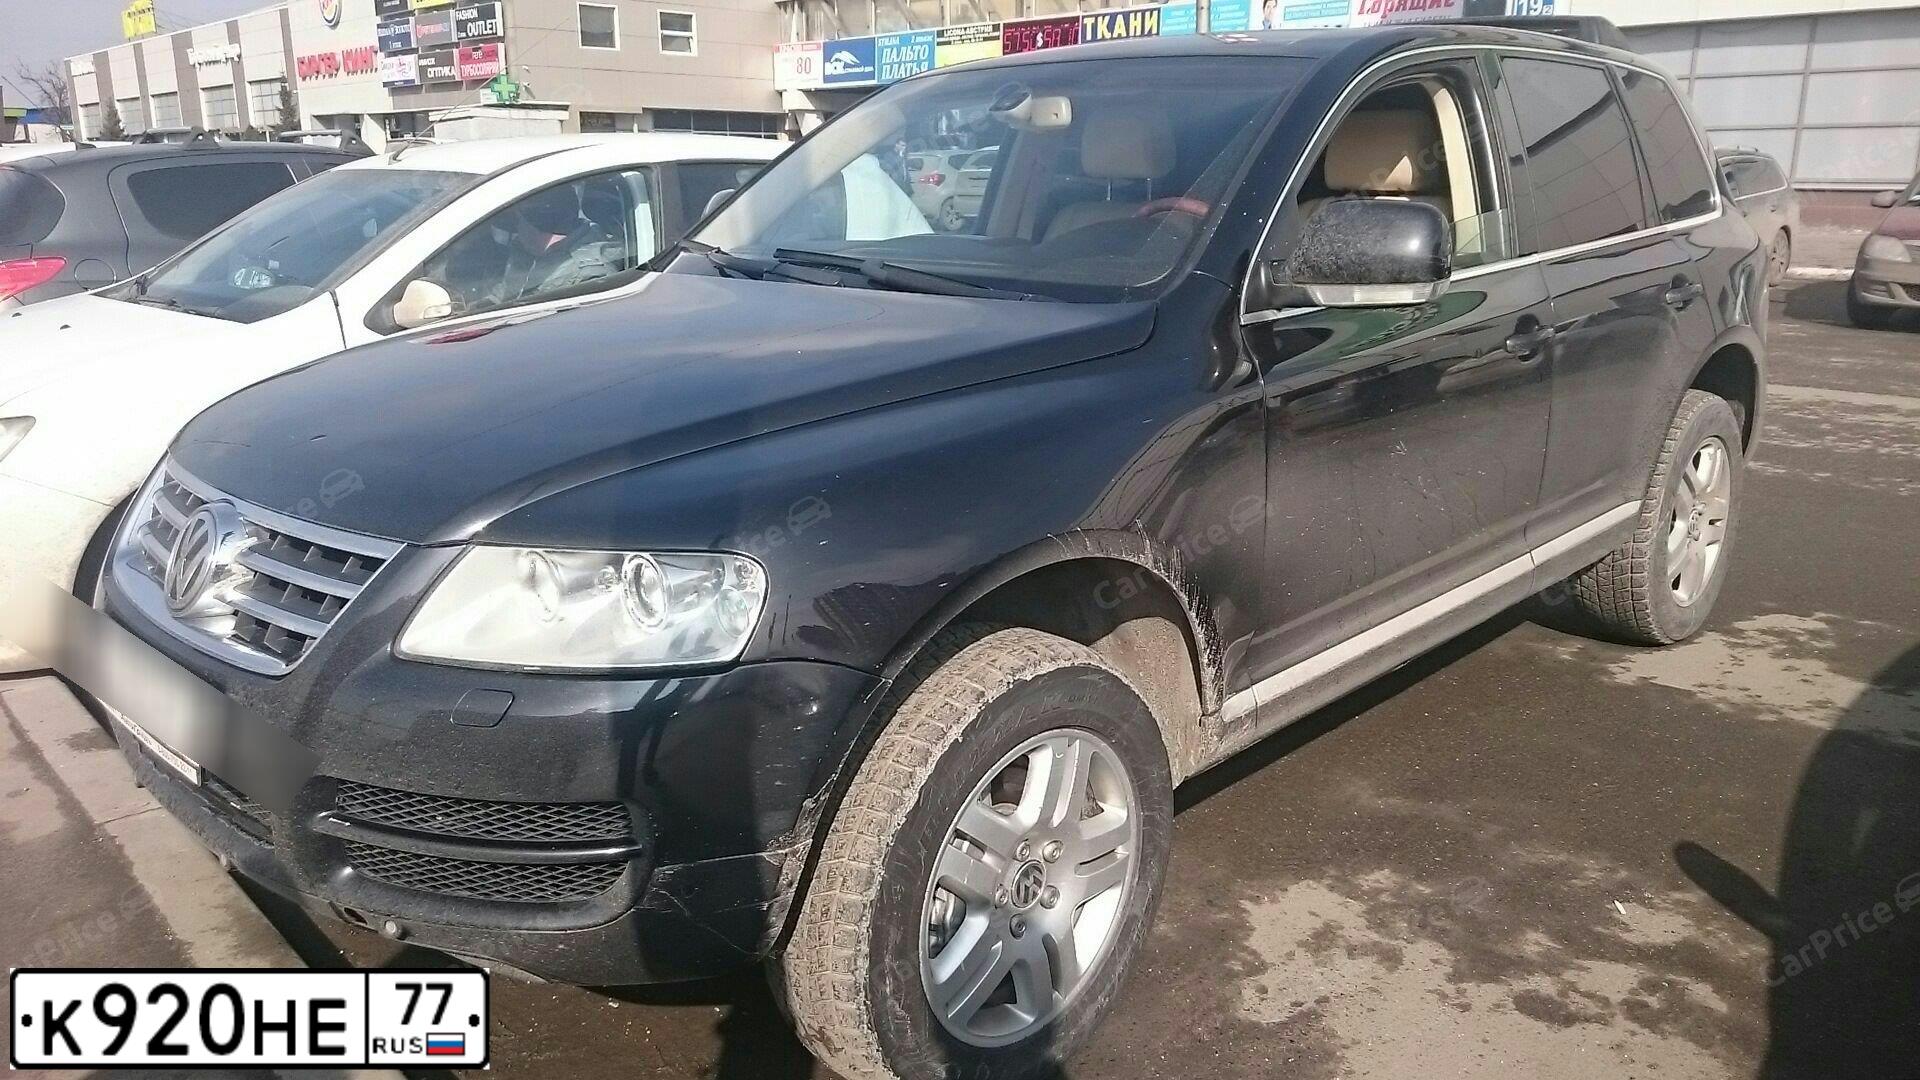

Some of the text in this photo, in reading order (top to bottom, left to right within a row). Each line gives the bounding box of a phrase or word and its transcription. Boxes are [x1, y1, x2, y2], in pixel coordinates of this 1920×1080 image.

[456, 8, 478, 20] FASHION
[467, 19, 497, 37] OUTLET
[1083, 10, 1159, 41] ТКАНИ
[881, 44, 929, 64] ПАЛЬТО
[881, 61, 929, 80] ПЛАТЬЯ
